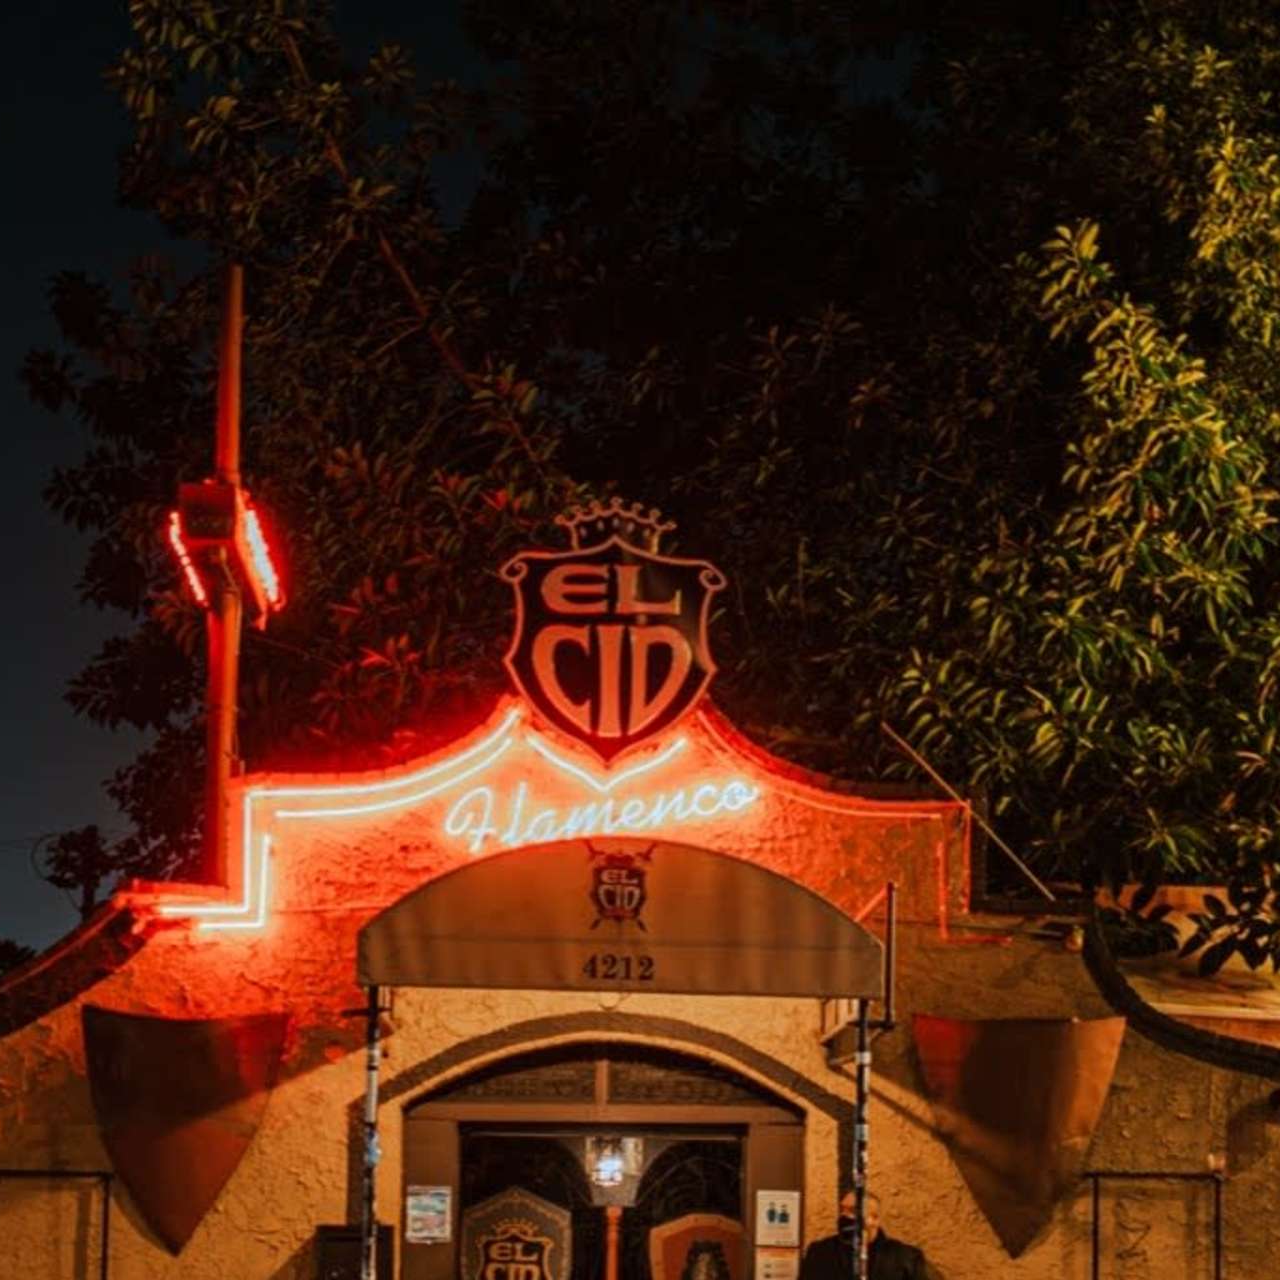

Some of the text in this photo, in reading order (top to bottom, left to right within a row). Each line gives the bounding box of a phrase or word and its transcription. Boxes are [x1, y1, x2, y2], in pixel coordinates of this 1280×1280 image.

[540, 564, 682, 615] EL
[531, 624, 694, 738] CID
[444, 780, 760, 854] Flamenco
[600, 869, 639, 884] EL
[598, 885, 640, 910] CID
[583, 954, 655, 981] 4212
[489, 1242, 539, 1261] EL
